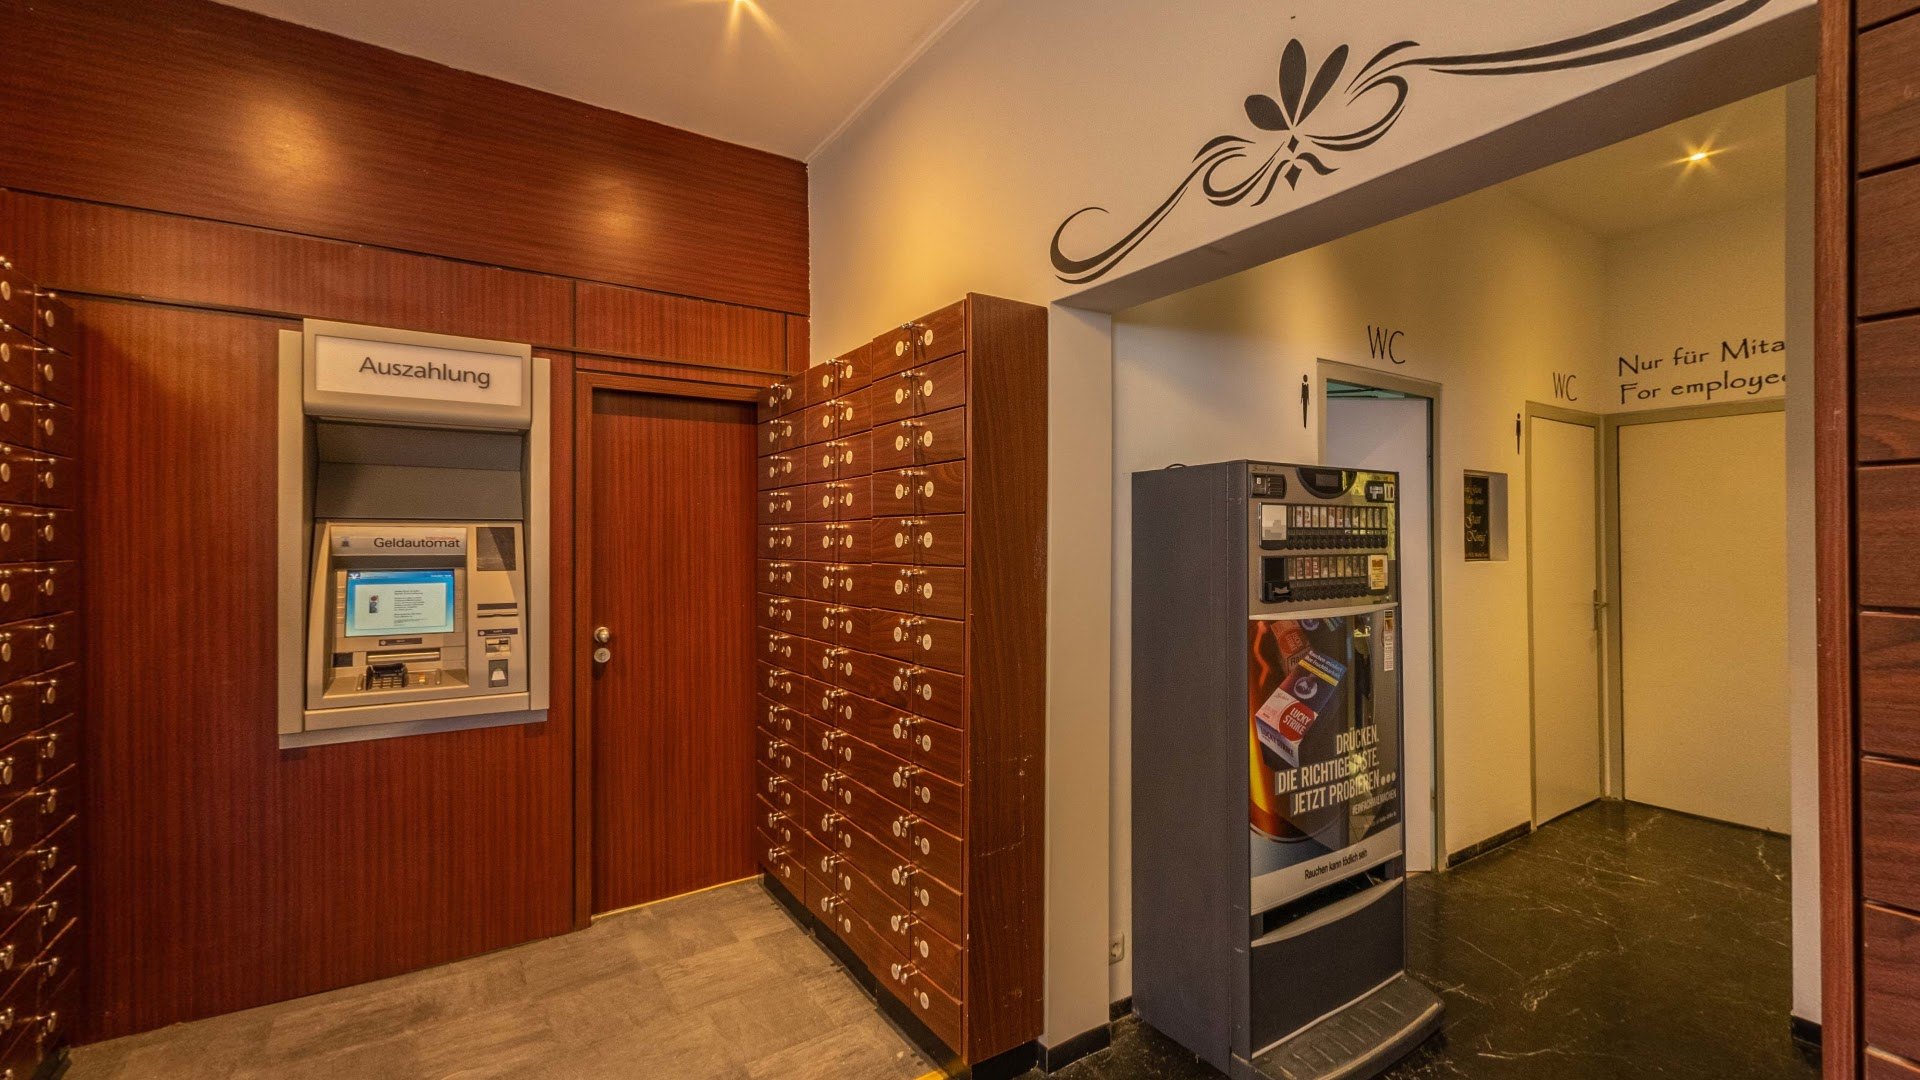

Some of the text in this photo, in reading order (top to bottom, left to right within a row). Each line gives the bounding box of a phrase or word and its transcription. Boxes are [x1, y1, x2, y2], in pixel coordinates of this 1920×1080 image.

[1367, 324, 1406, 365] WC
[358, 356, 491, 389] Auszahlung
[1618, 354, 1663, 377] Nur
[1673, 347, 1709, 366] für
[1552, 371, 1578, 402] WC
[1620, 382, 1661, 404] For
[373, 537, 460, 548] Geldautomat
[1282, 714, 1307, 735] STRIKE
[1290, 707, 1312, 725] LUCKY
[1336, 724, 1379, 754] DRÜCKEN.
[1278, 769, 1298, 793] DIE
[1301, 756, 1351, 788] RICHTIGE
[1293, 786, 1326, 815] JETZT
[1304, 866, 1329, 880] Rauchen
[1328, 861, 1342, 872] kann
[1342, 853, 1359, 867] tödlich
